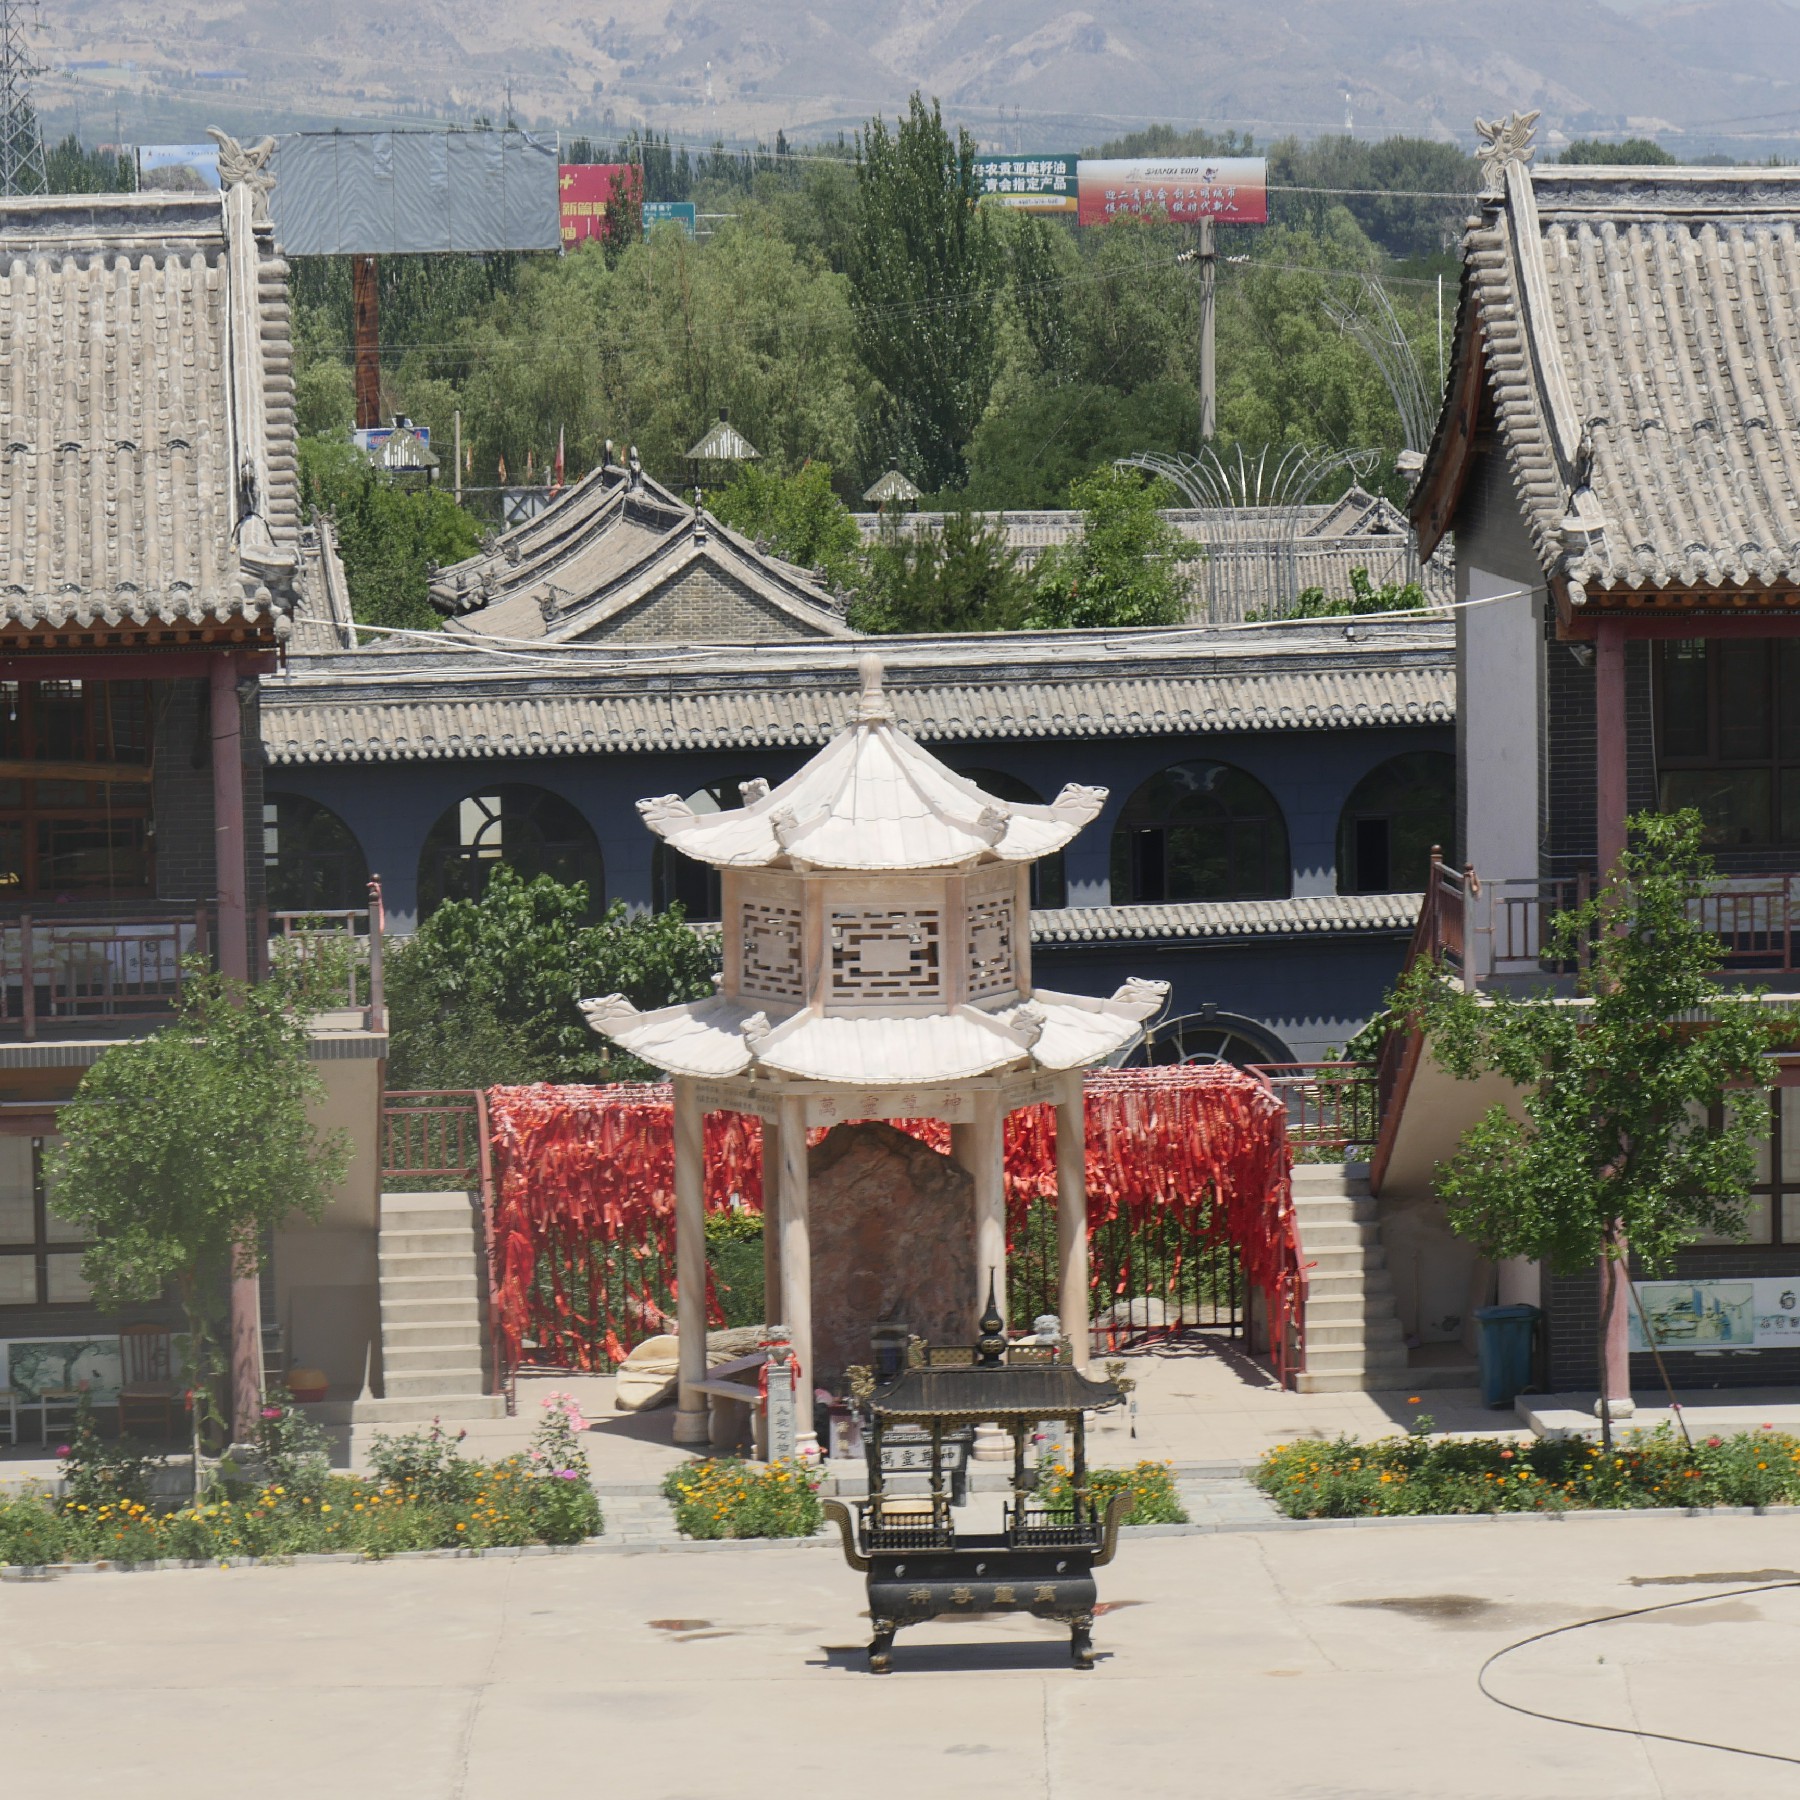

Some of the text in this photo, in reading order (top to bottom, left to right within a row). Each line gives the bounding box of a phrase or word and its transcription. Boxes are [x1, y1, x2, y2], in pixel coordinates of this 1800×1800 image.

[979, 176, 1067, 192] 青会指定产品
